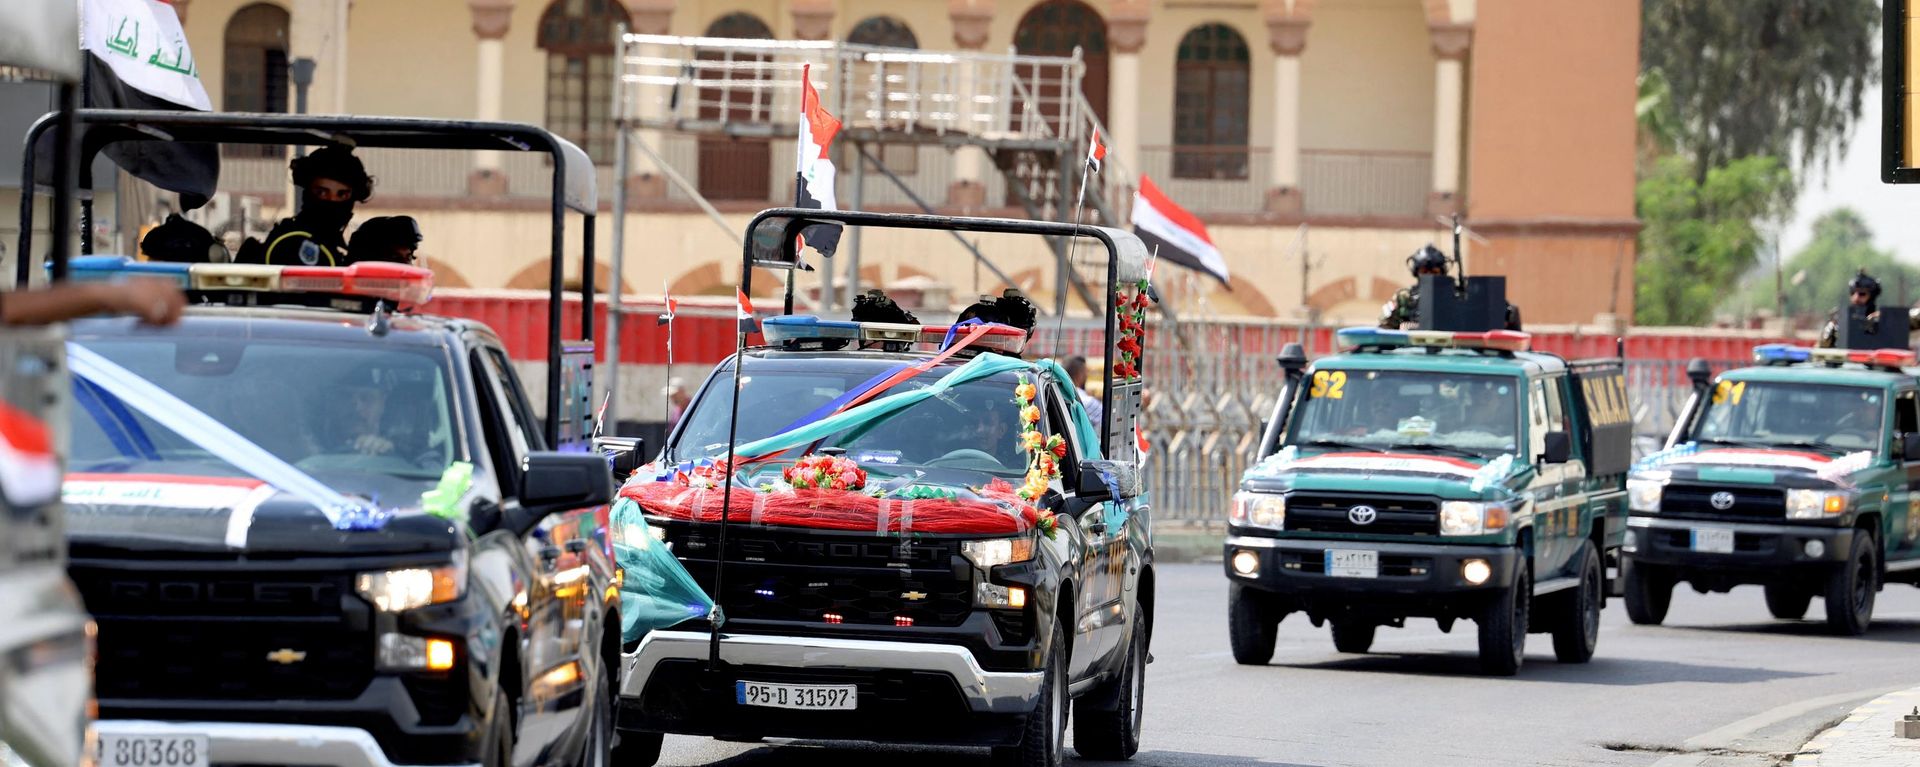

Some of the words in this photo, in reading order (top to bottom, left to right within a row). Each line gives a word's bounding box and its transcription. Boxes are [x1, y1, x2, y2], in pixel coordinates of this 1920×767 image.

[148, 33, 199, 78] لله
[1310, 370, 1347, 399] S2
[1712, 379, 1745, 405] S1
[112, 581, 334, 603] ROLET
[795, 689, 849, 707] 31597
[116, 738, 196, 766] 80368
